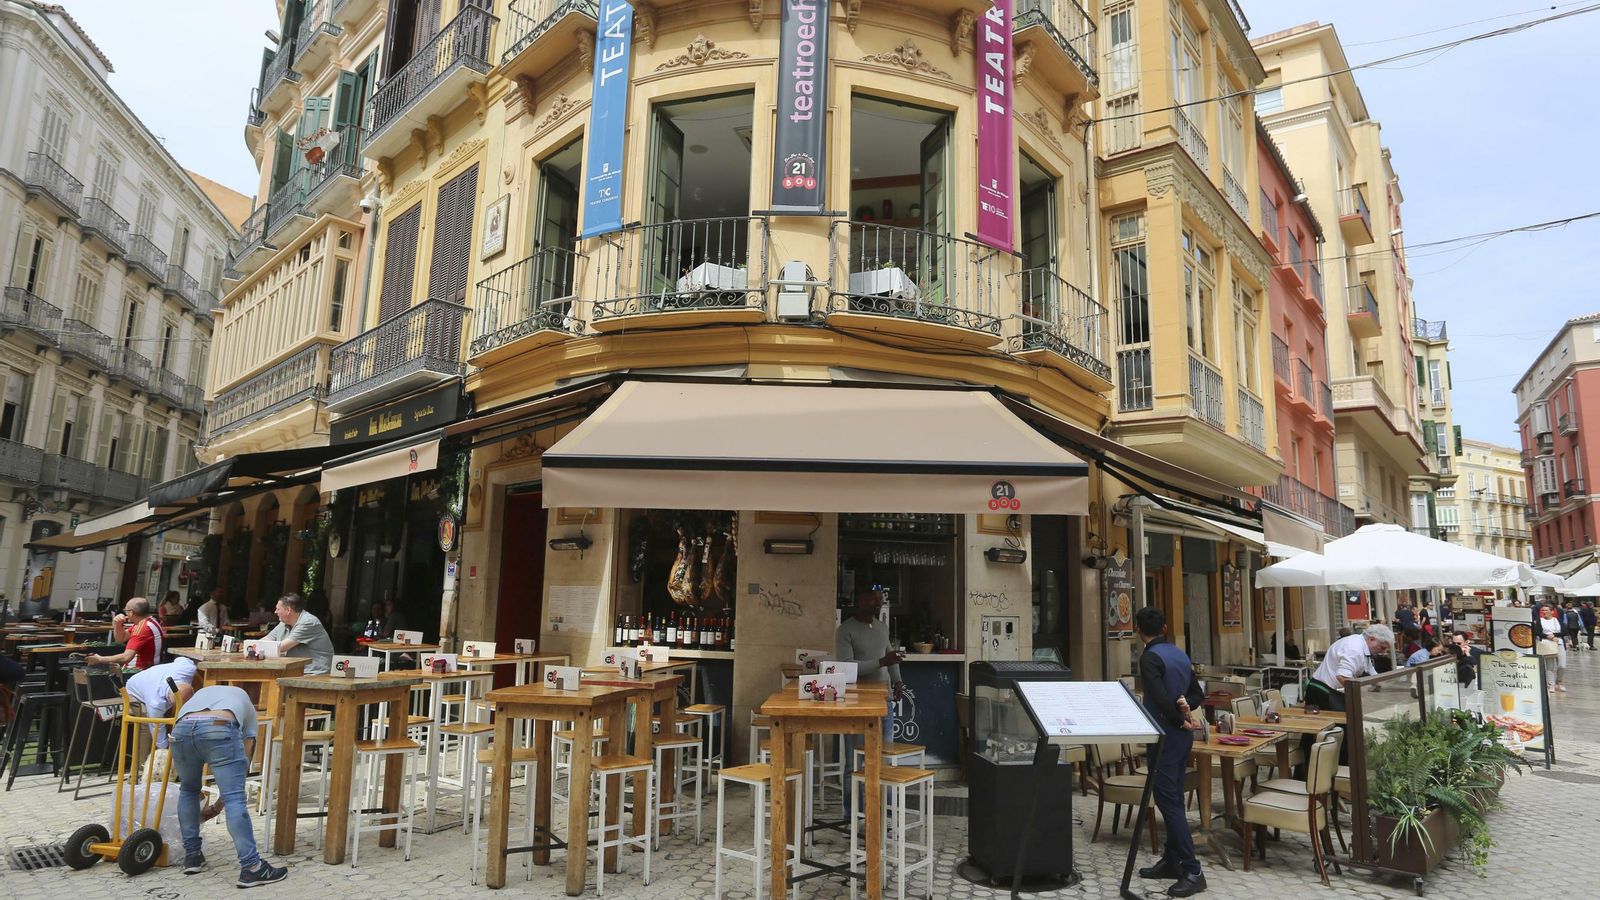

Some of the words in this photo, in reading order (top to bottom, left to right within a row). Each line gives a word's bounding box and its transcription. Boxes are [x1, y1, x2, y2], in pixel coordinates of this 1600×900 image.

[601, 4, 627, 87] TEAT
[792, 162, 806, 175] 21
[786, 178, 814, 188] BOU
[996, 484, 1010, 496] 21
[991, 498, 1018, 508] BOU
[1491, 660, 1506, 668] The
